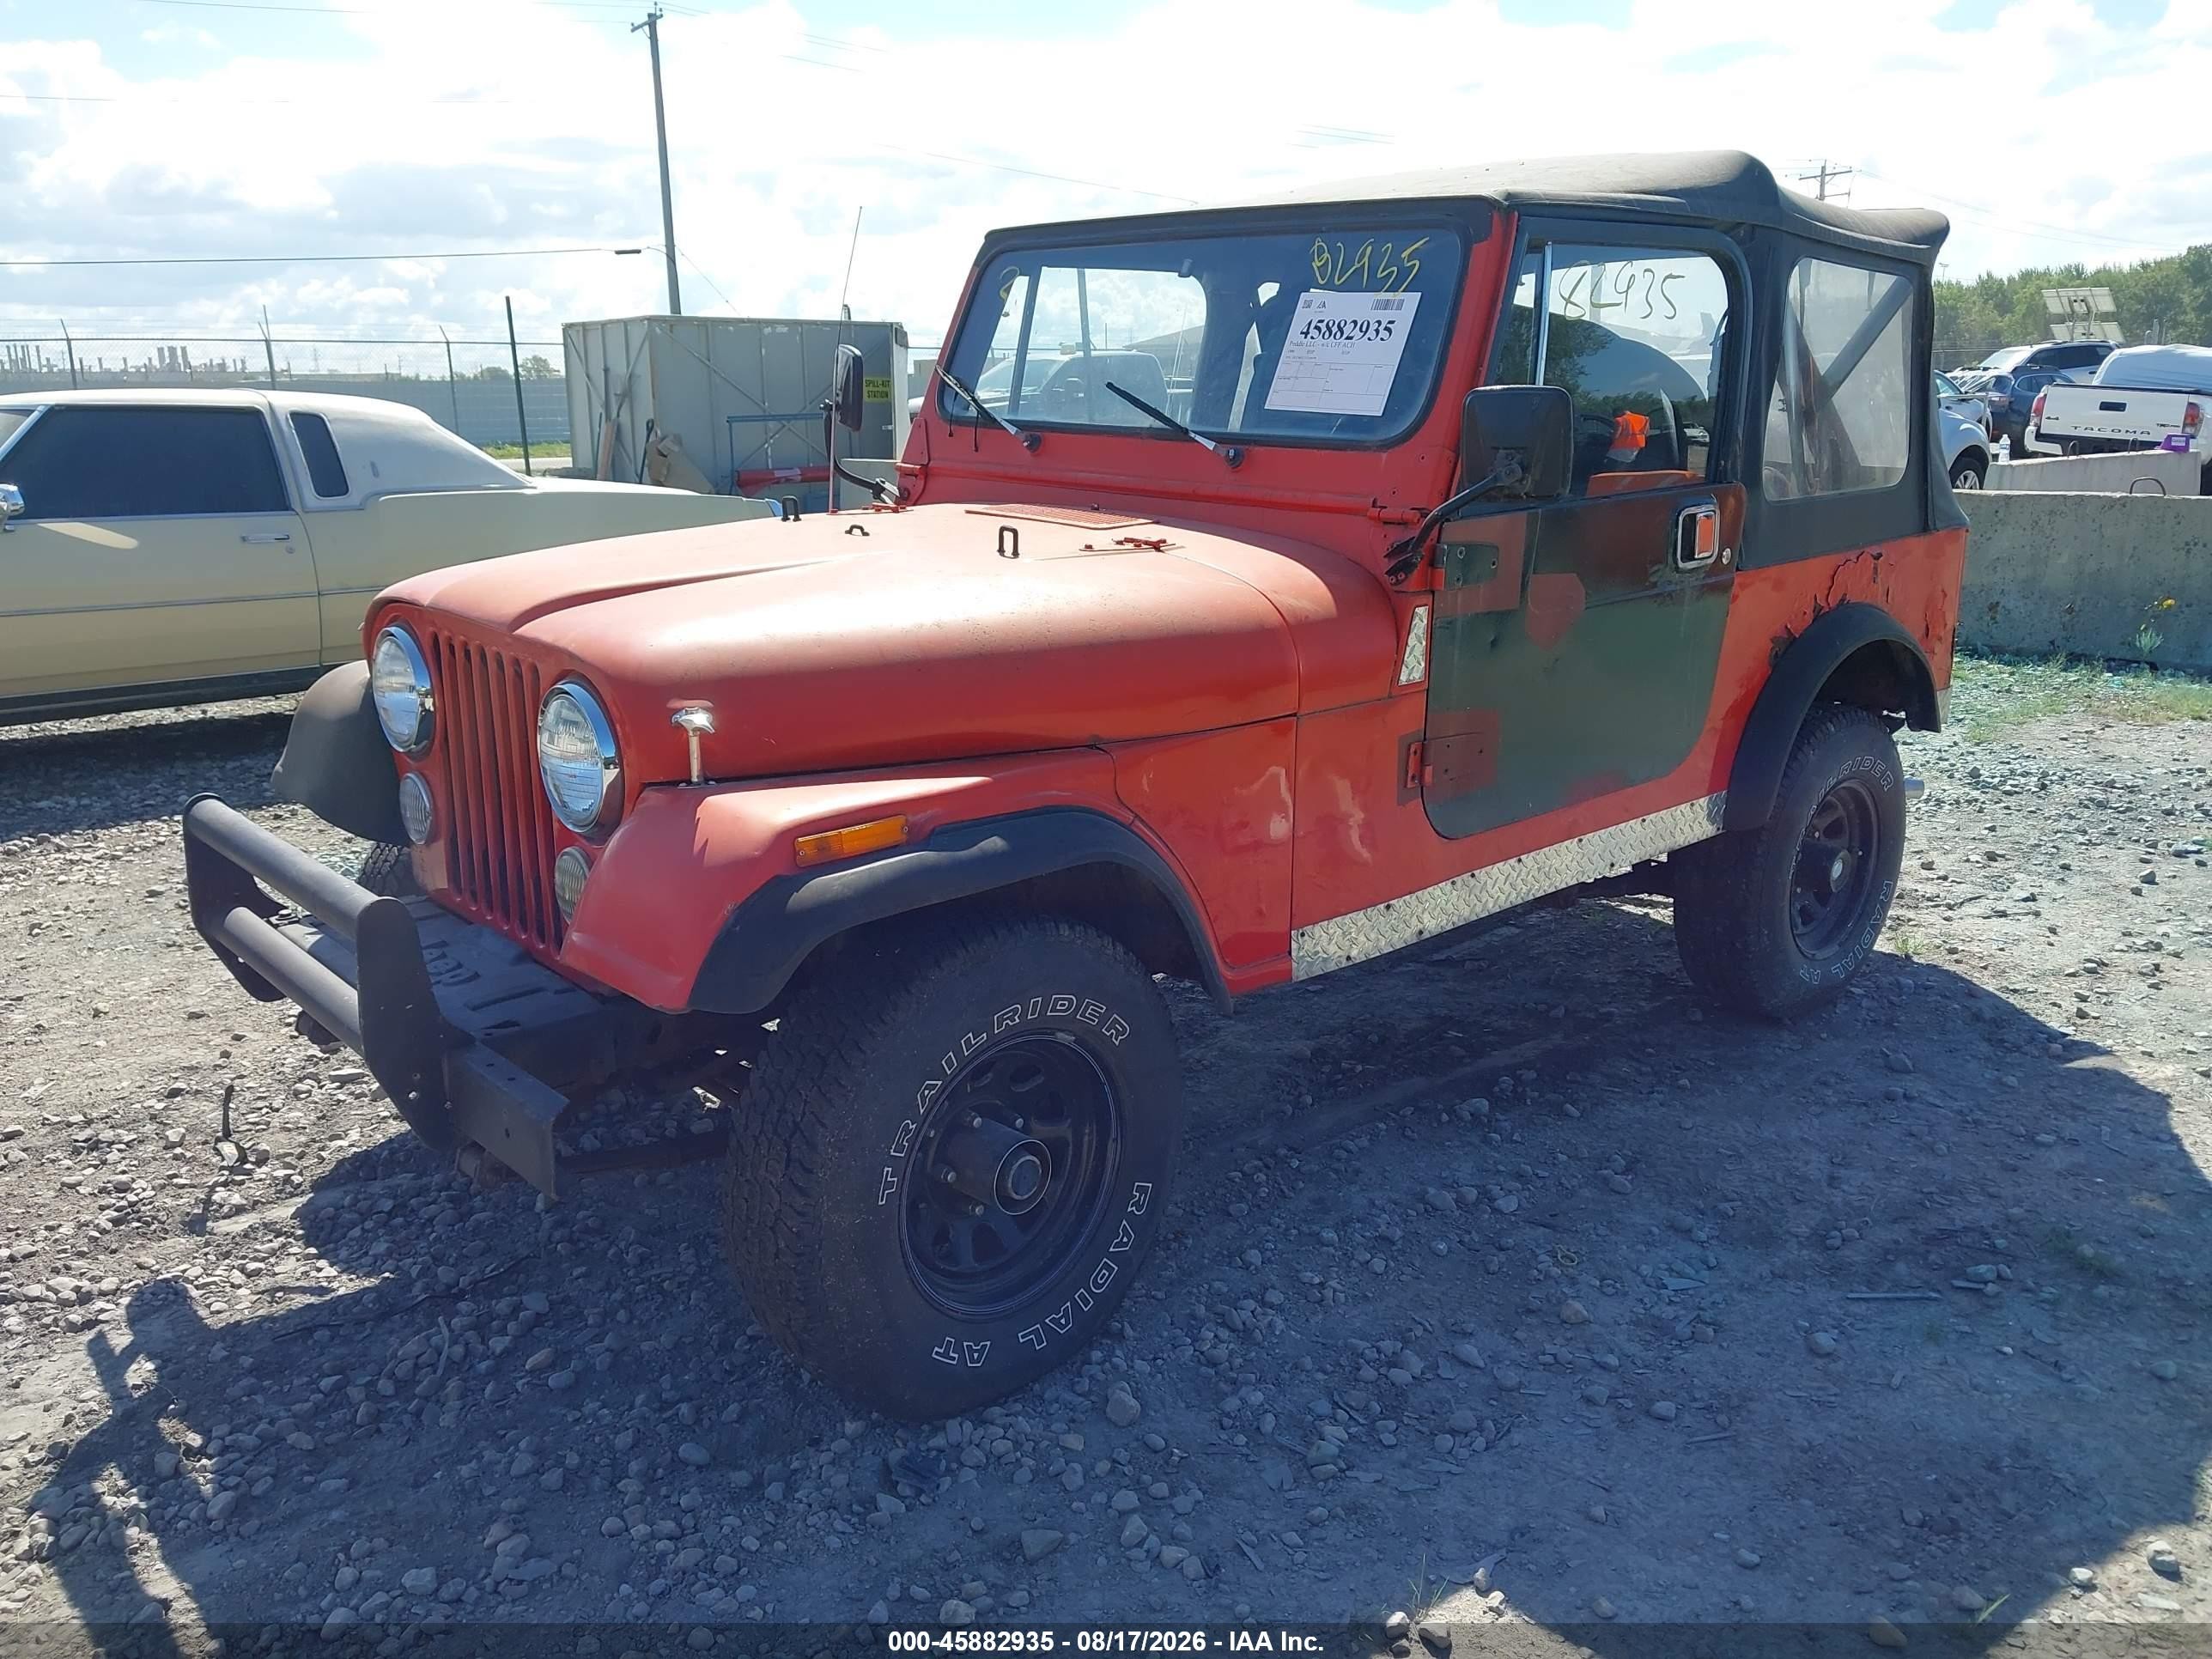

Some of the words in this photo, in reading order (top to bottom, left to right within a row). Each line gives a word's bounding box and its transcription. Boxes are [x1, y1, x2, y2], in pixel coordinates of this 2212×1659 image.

[1559, 259, 1686, 320] 82935
[1299, 318, 1396, 342] 45882935
[867, 390, 889, 398] STATION
[2070, 425, 2151, 435] TACOMA
[1831, 880, 1893, 979] RADIAL
[1800, 965, 1821, 985] AT
[1018, 1182, 1152, 1351] RADIAL
[933, 1336, 991, 1367] AT
